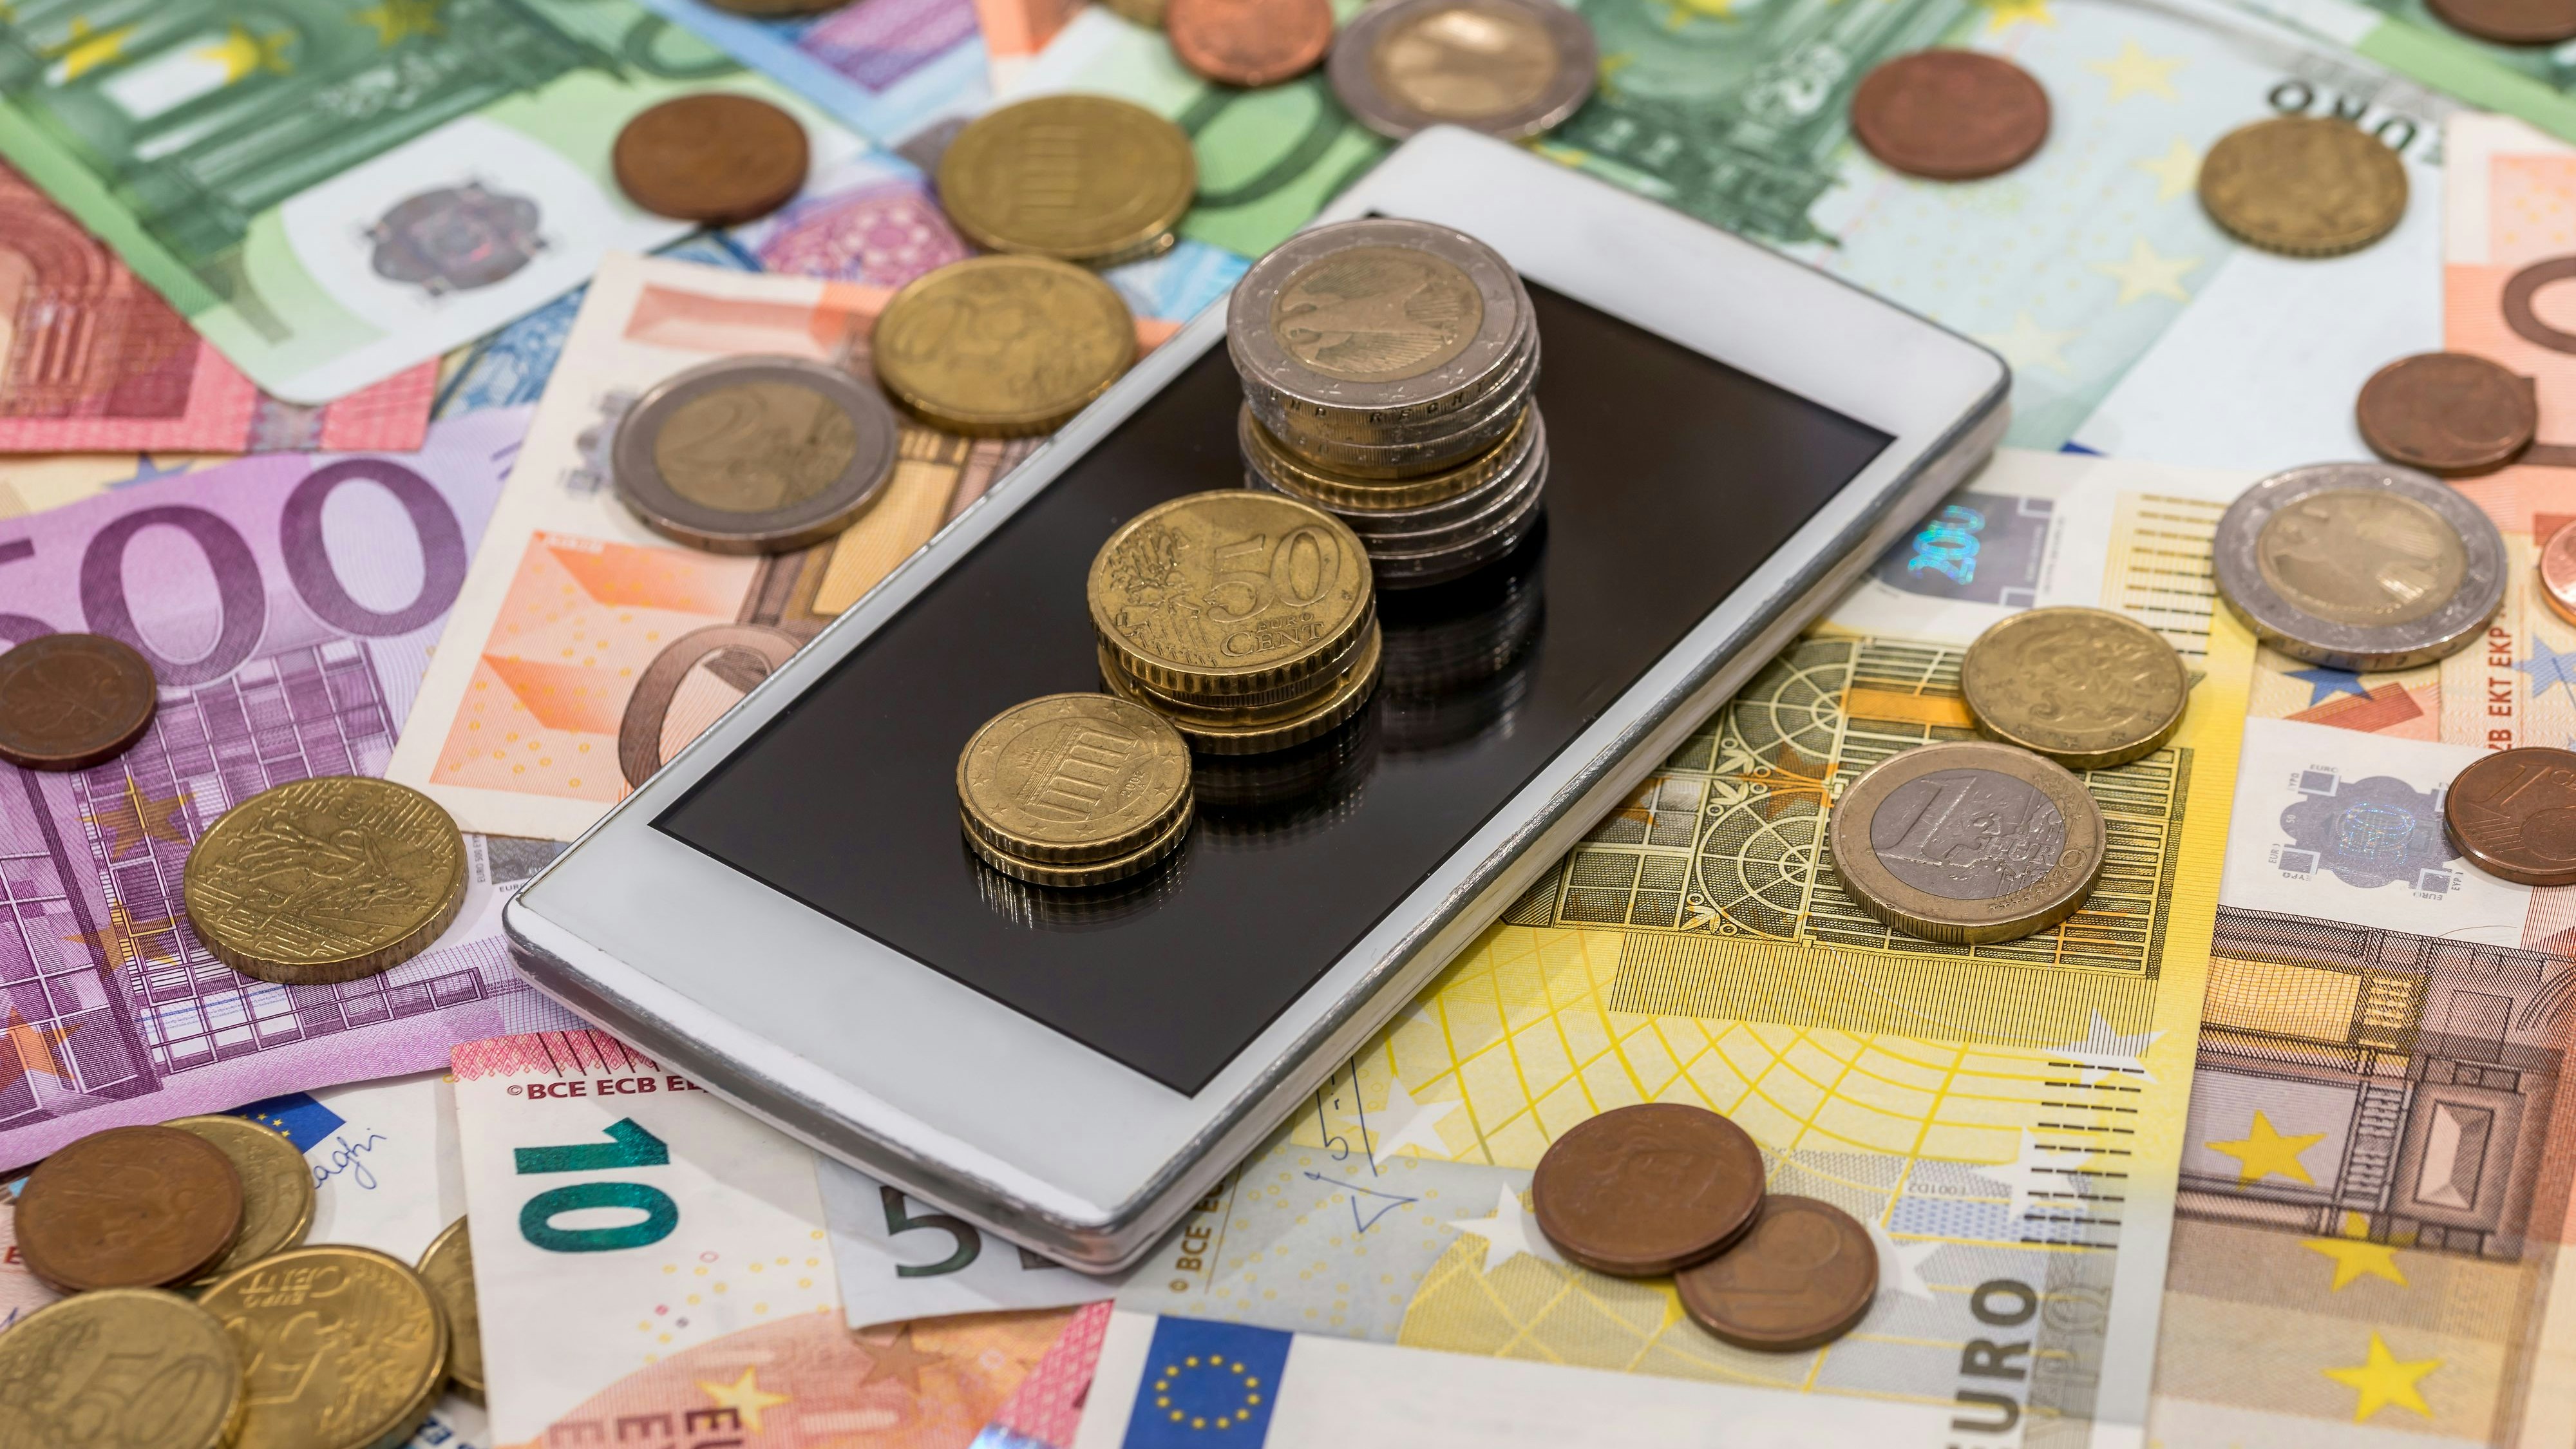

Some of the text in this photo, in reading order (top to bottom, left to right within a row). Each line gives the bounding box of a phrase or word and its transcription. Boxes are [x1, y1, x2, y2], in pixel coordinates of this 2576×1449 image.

[1908, 504, 1986, 585] 200
[1203, 524, 1340, 623] 50
[1220, 621, 1325, 658] CENT
[1256, 612, 1314, 633] EURO
[2488, 627, 2512, 667] EKP
[2488, 676, 2512, 717] EKT
[1873, 774, 1977, 866] 1
[1979, 835, 2088, 870] EURO
[527, 1081, 587, 1100] BCE
[597, 1077, 657, 1096] ECB
[513, 1117, 679, 1253] 10
[1175, 1225, 1212, 1273] BCE
[1945, 1278, 2038, 1449] URO
